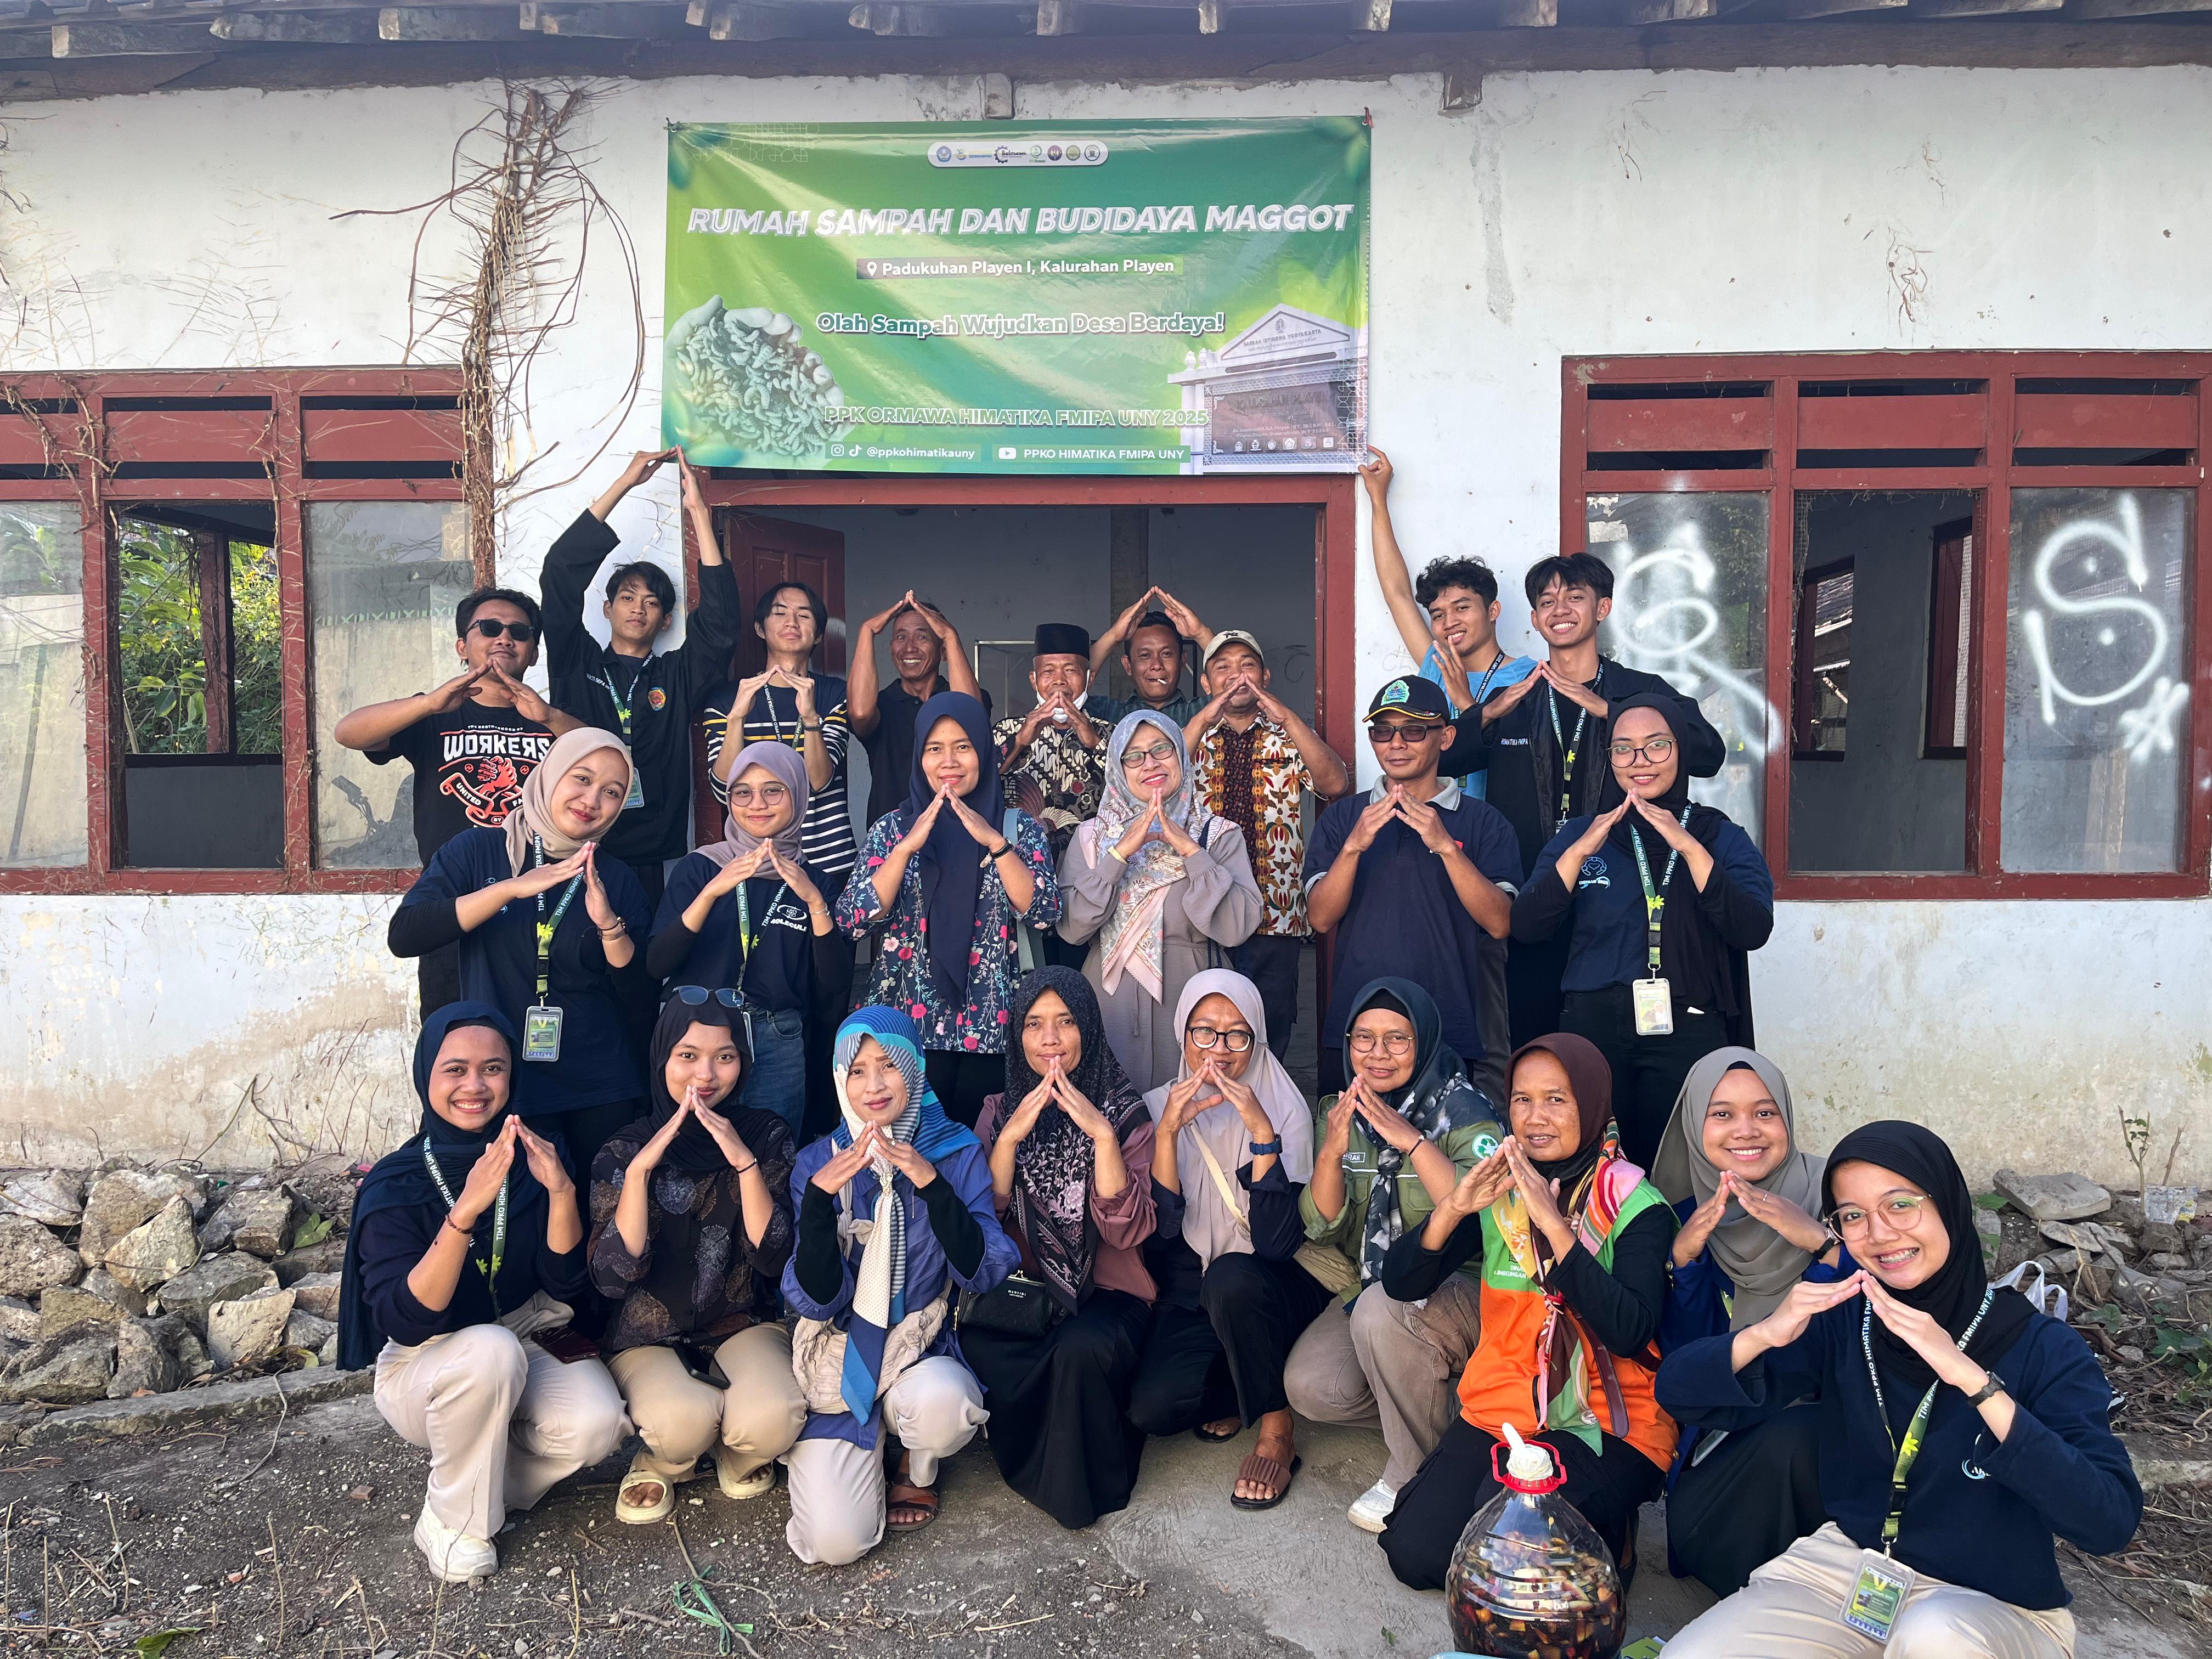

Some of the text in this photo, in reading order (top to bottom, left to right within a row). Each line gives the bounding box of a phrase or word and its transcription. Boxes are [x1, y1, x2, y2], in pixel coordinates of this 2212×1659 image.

[687, 204, 1355, 236] RUMAH SAMPAH DAN BUDIDAYA MAGGOT
[882, 259, 1174, 277] Padukuhan Playen I, Kalurahan Playen
[816, 312, 1225, 340] Olah Sampah Wujudkan Desa Berdaya!
[1263, 335, 1286, 343] ISTIMEWA
[1287, 329, 1322, 339] YOGYAKARTA
[824, 406, 1210, 427] PPK ORMAWA HIMATIKA FMIPA UNY 2025
[867, 445, 975, 460] @ppkohimatikauny
[1024, 448, 1184, 460] PPKO HIMATIKA FMIPA UNY
[456, 782, 482, 806] UNITED
[1682, 809, 1690, 820] UNY
[1634, 833, 1645, 862] HIMATIKA
[1640, 861, 1648, 876] PPKO
[1666, 860, 1675, 875] PPKO
[1662, 875, 1671, 886] TIM
[555, 906, 563, 916] TIM
[563, 893, 572, 907] PPKO
[761, 916, 771, 927] TIM
[766, 902, 777, 917] PPKO
[424, 1151, 435, 1165] UNY
[430, 1164, 445, 1186] FMIPA
[497, 1206, 505, 1226] PPKO
[1494, 1269, 1527, 1279] LINGKUNGAN
[1978, 1297, 1990, 1315] UNY
[1862, 1316, 1872, 1360] HIMATIKA
[1869, 1362, 1878, 1386] PPKO
[1917, 1401, 1929, 1419] TIM
